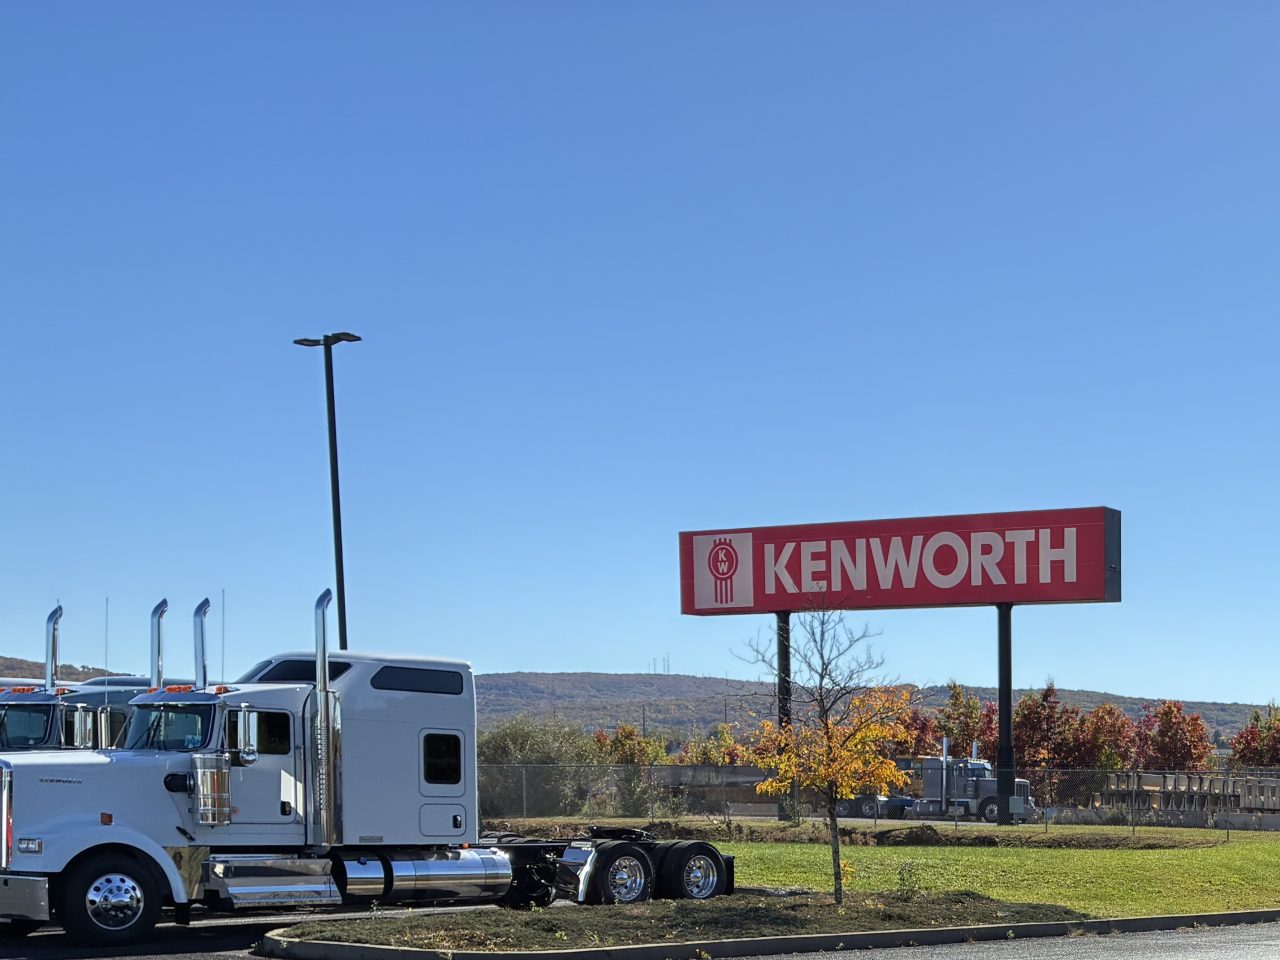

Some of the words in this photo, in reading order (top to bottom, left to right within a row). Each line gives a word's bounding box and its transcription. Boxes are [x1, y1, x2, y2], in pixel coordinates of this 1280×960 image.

[718, 549, 727, 561] K
[764, 527, 1077, 595] KENWORTH
[717, 561, 729, 573] W
